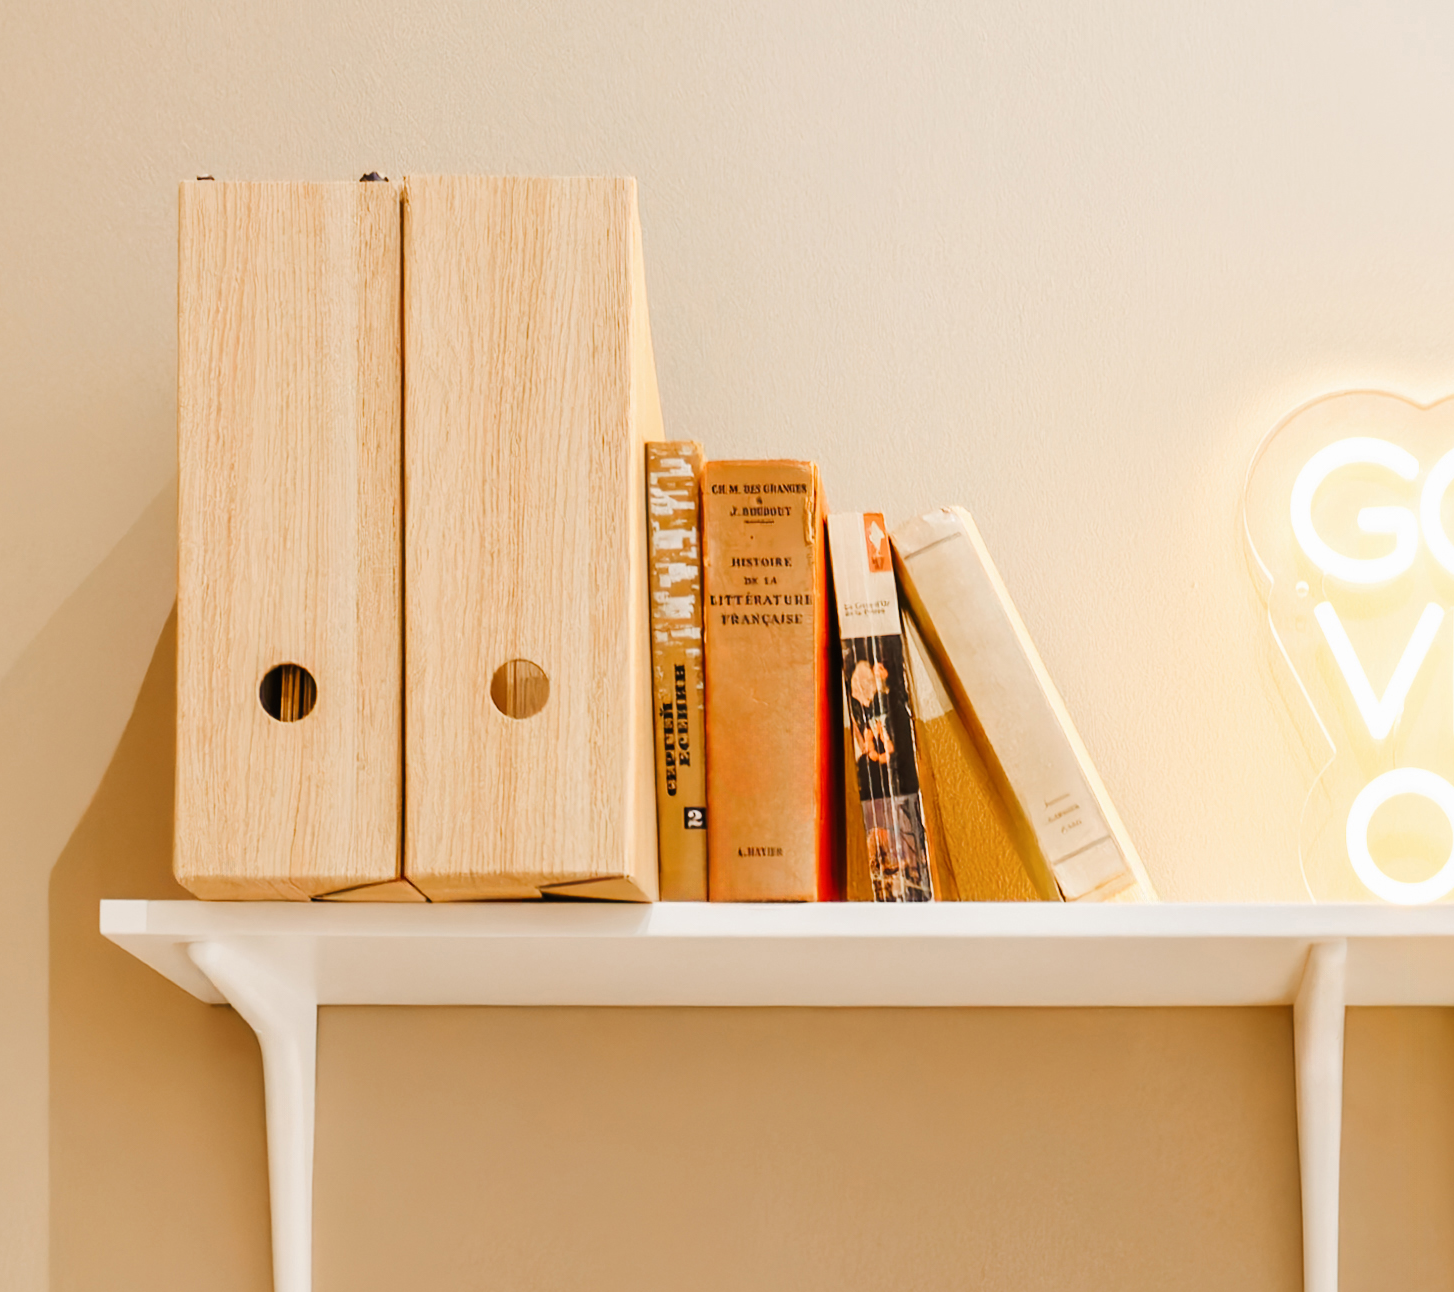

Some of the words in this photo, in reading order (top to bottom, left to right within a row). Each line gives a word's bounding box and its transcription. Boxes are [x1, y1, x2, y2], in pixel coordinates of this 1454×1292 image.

[730, 556, 793, 568] HISTOIRE
[743, 575, 758, 586] DE
[763, 575, 778, 585] LA
[709, 590, 813, 607] LITTÉRATURE
[721, 612, 803, 628] FRANÇAISE
[674, 664, 691, 767] ЕСЕНИН
[660, 702, 677, 797] СЕРГЕЙ
[687, 808, 703, 829] 2
